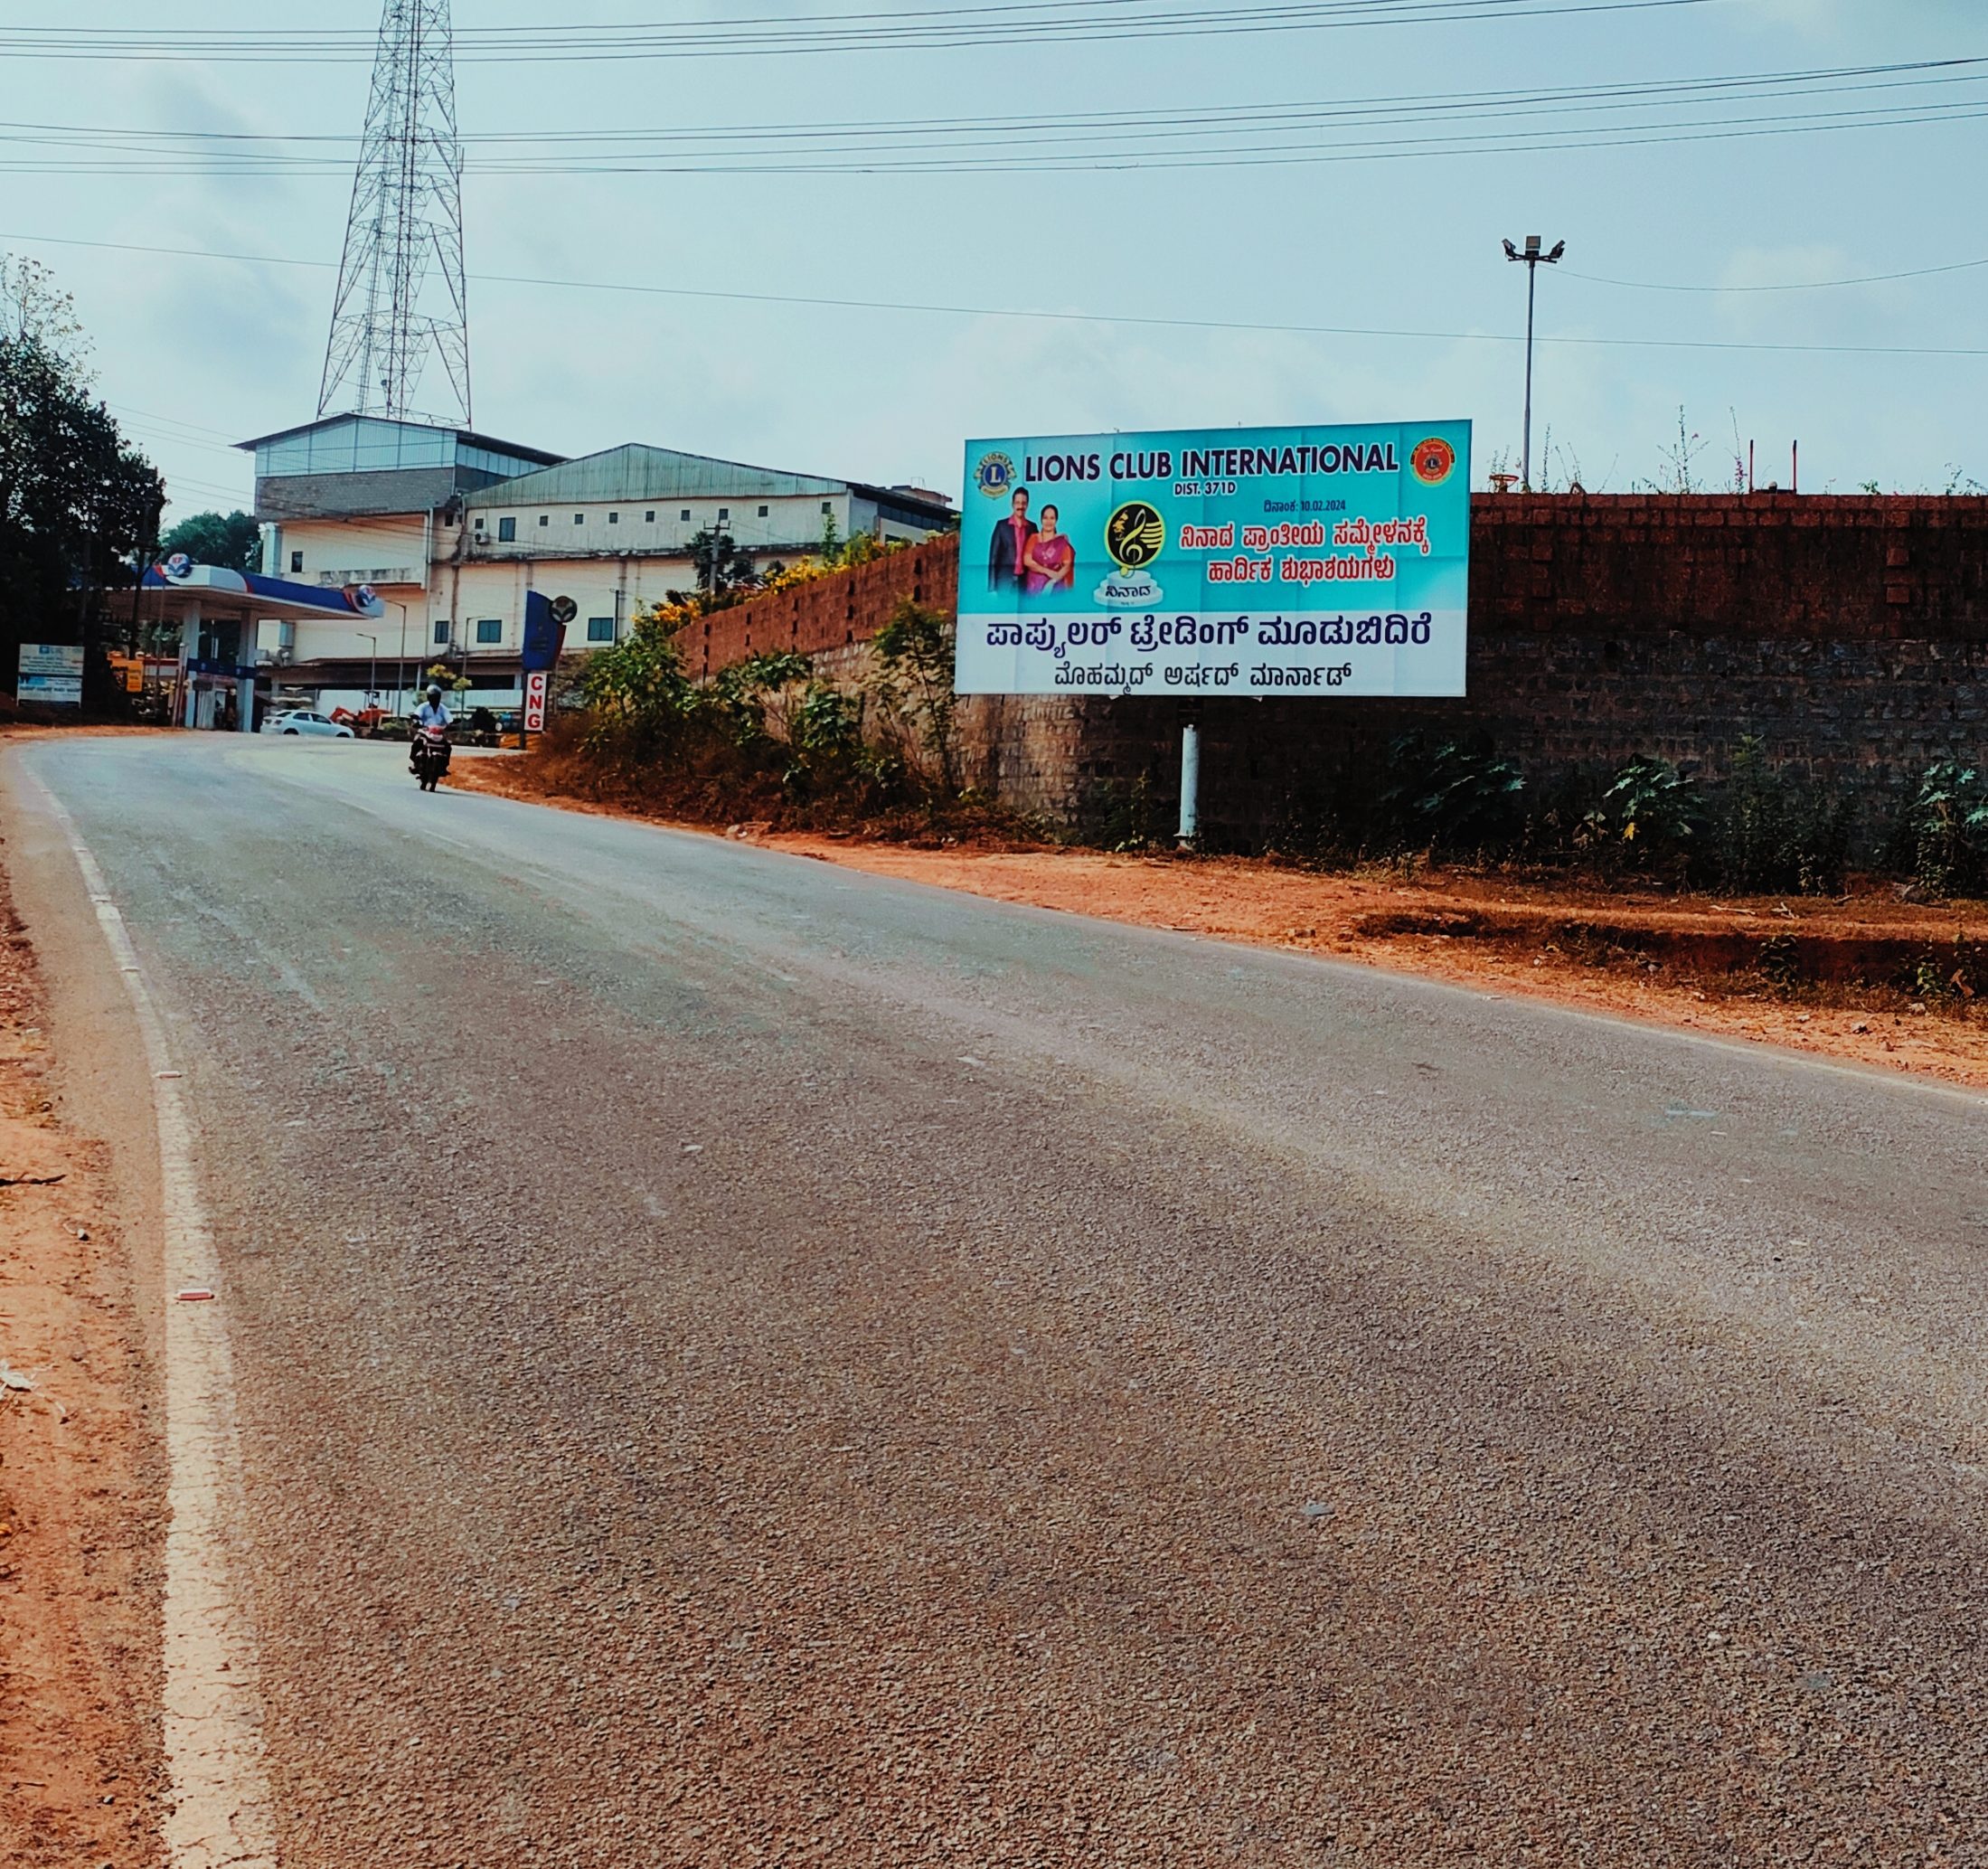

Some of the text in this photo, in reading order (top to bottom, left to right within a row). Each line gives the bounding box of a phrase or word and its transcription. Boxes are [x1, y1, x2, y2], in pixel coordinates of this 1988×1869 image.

[1025, 454, 1100, 482] LIONS
[1109, 450, 1172, 480] CLUB
[1182, 444, 1399, 477] INTERNATIONAL
[1174, 481, 1236, 496] DIST. 371D
[1300, 499, 1345, 512] 10.02.2024
[1181, 516, 1428, 554] ನಿನಾದ ಪ್ರಾಂತೀಯ ಸಮ್ಮೇಳನಕ್ಕೆ
[1209, 554, 1394, 585] ಹಾರ್ದಿಕ ಶುಭಾಶಯಗಳು
[1105, 585, 1152, 598] ನಿನಾದ
[986, 612, 1432, 659] ಪಾಪ್ಯುಲರ್ ಟ್ರೇಡಿಂಗ್ ಮೂಡುಬಿದಿರೆ
[1054, 660, 1352, 695] ಮೊಹಮ್ಮದ್ ಅರ್ಷದ್ ಮಾರ್ನಾಡ್
[527, 675, 544, 729] CNG
